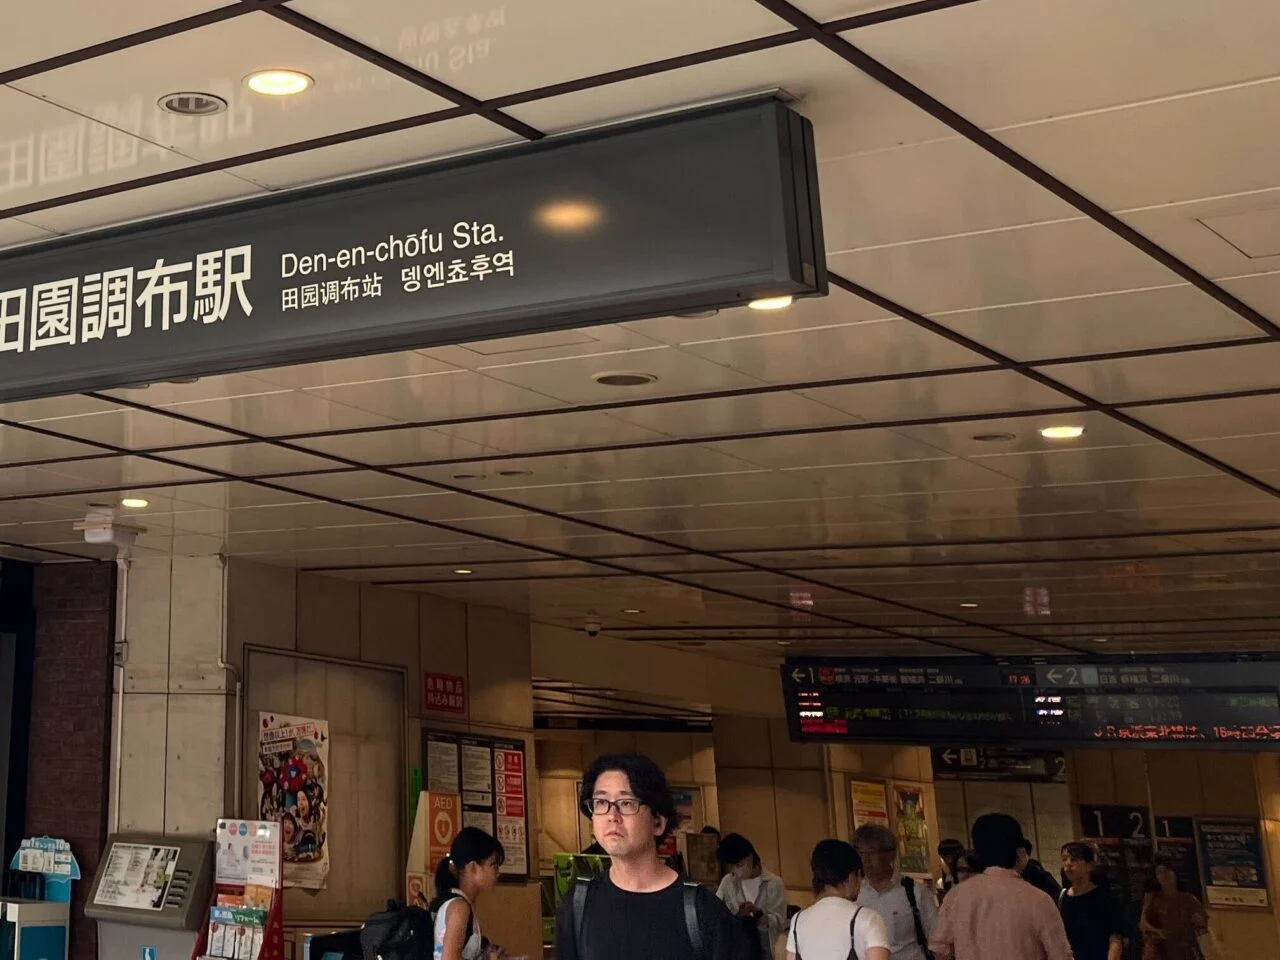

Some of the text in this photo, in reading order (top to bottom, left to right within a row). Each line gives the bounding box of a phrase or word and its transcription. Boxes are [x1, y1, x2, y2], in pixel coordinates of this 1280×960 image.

[281, 221, 505, 278] Den-en-chōfu Sta.
[281, 272, 383, 311] 田园调布站
[401, 250, 515, 293] 뎅엔쵸후역
[434, 797, 452, 809] AED
